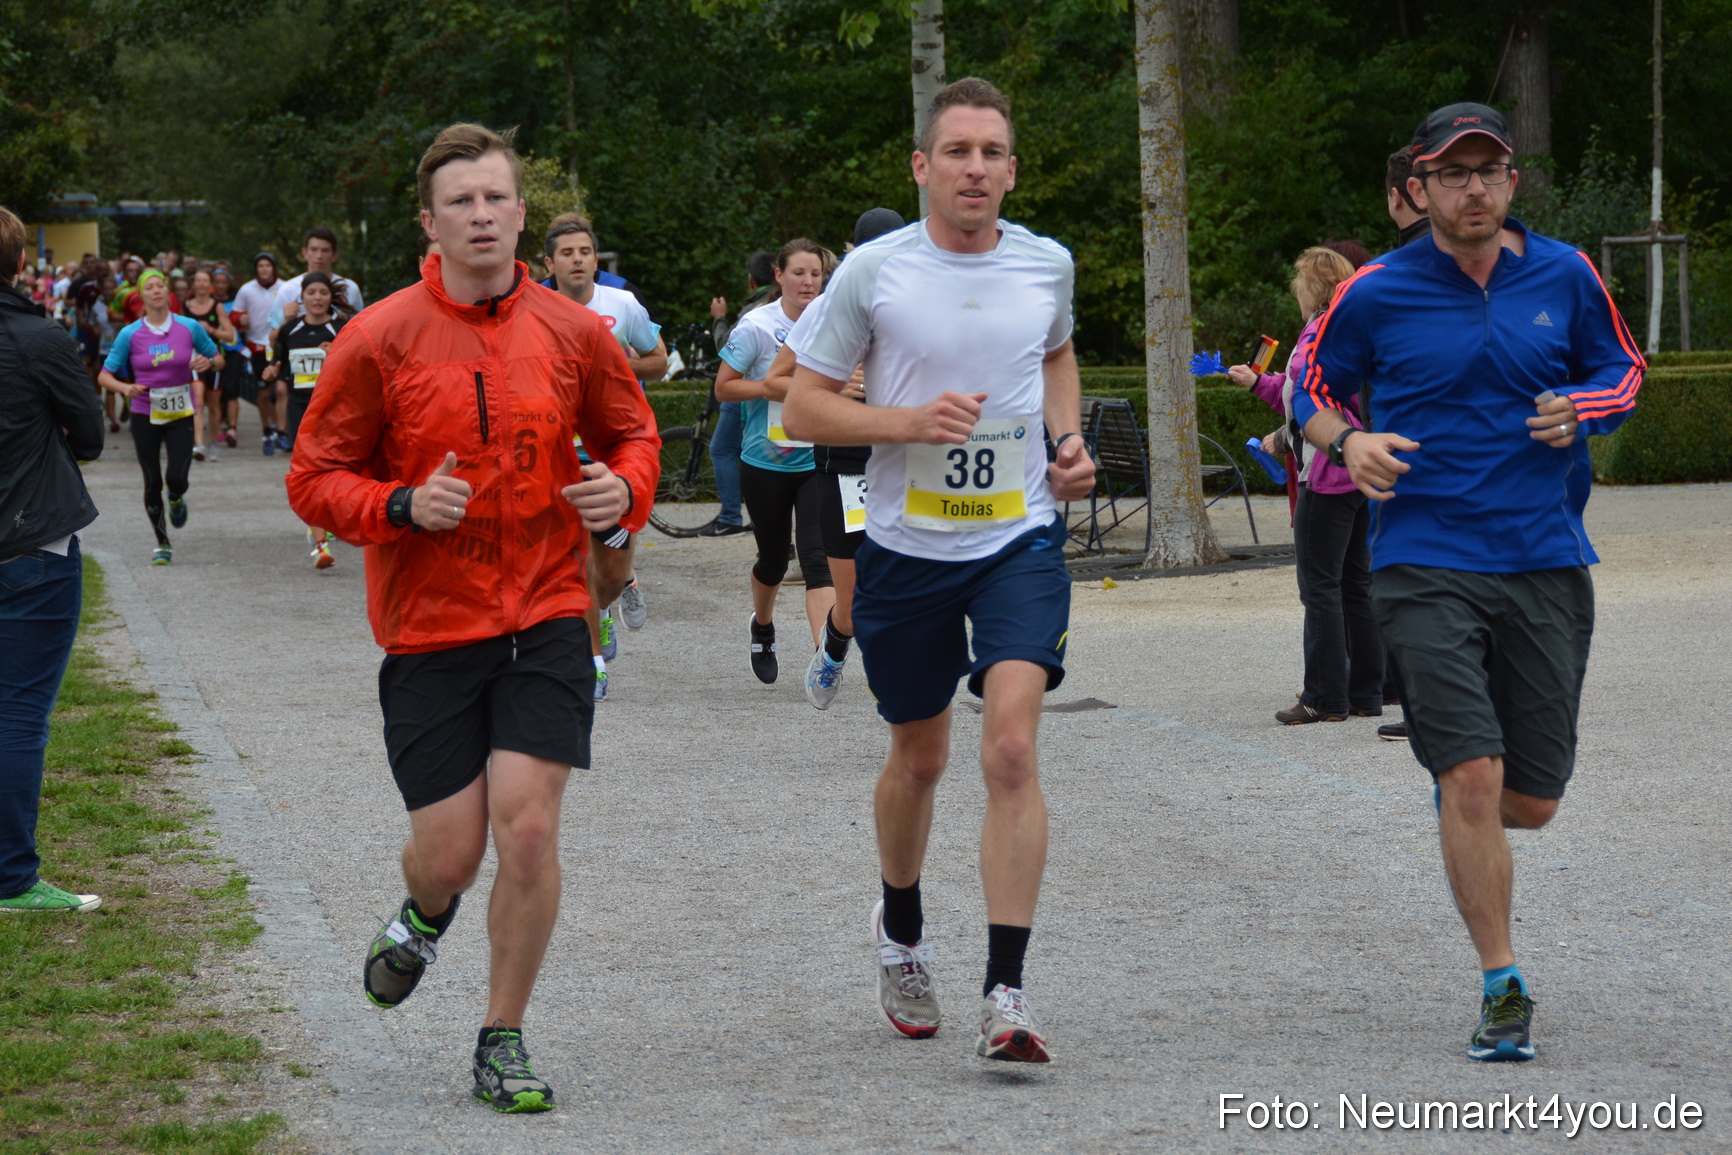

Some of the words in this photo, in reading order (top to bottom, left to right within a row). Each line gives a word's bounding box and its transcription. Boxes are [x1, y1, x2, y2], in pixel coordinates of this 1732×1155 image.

[160, 395, 185, 410] 313
[965, 430, 1011, 442] eumarkt
[945, 448, 995, 489] 38
[940, 499, 994, 516] Tobias
